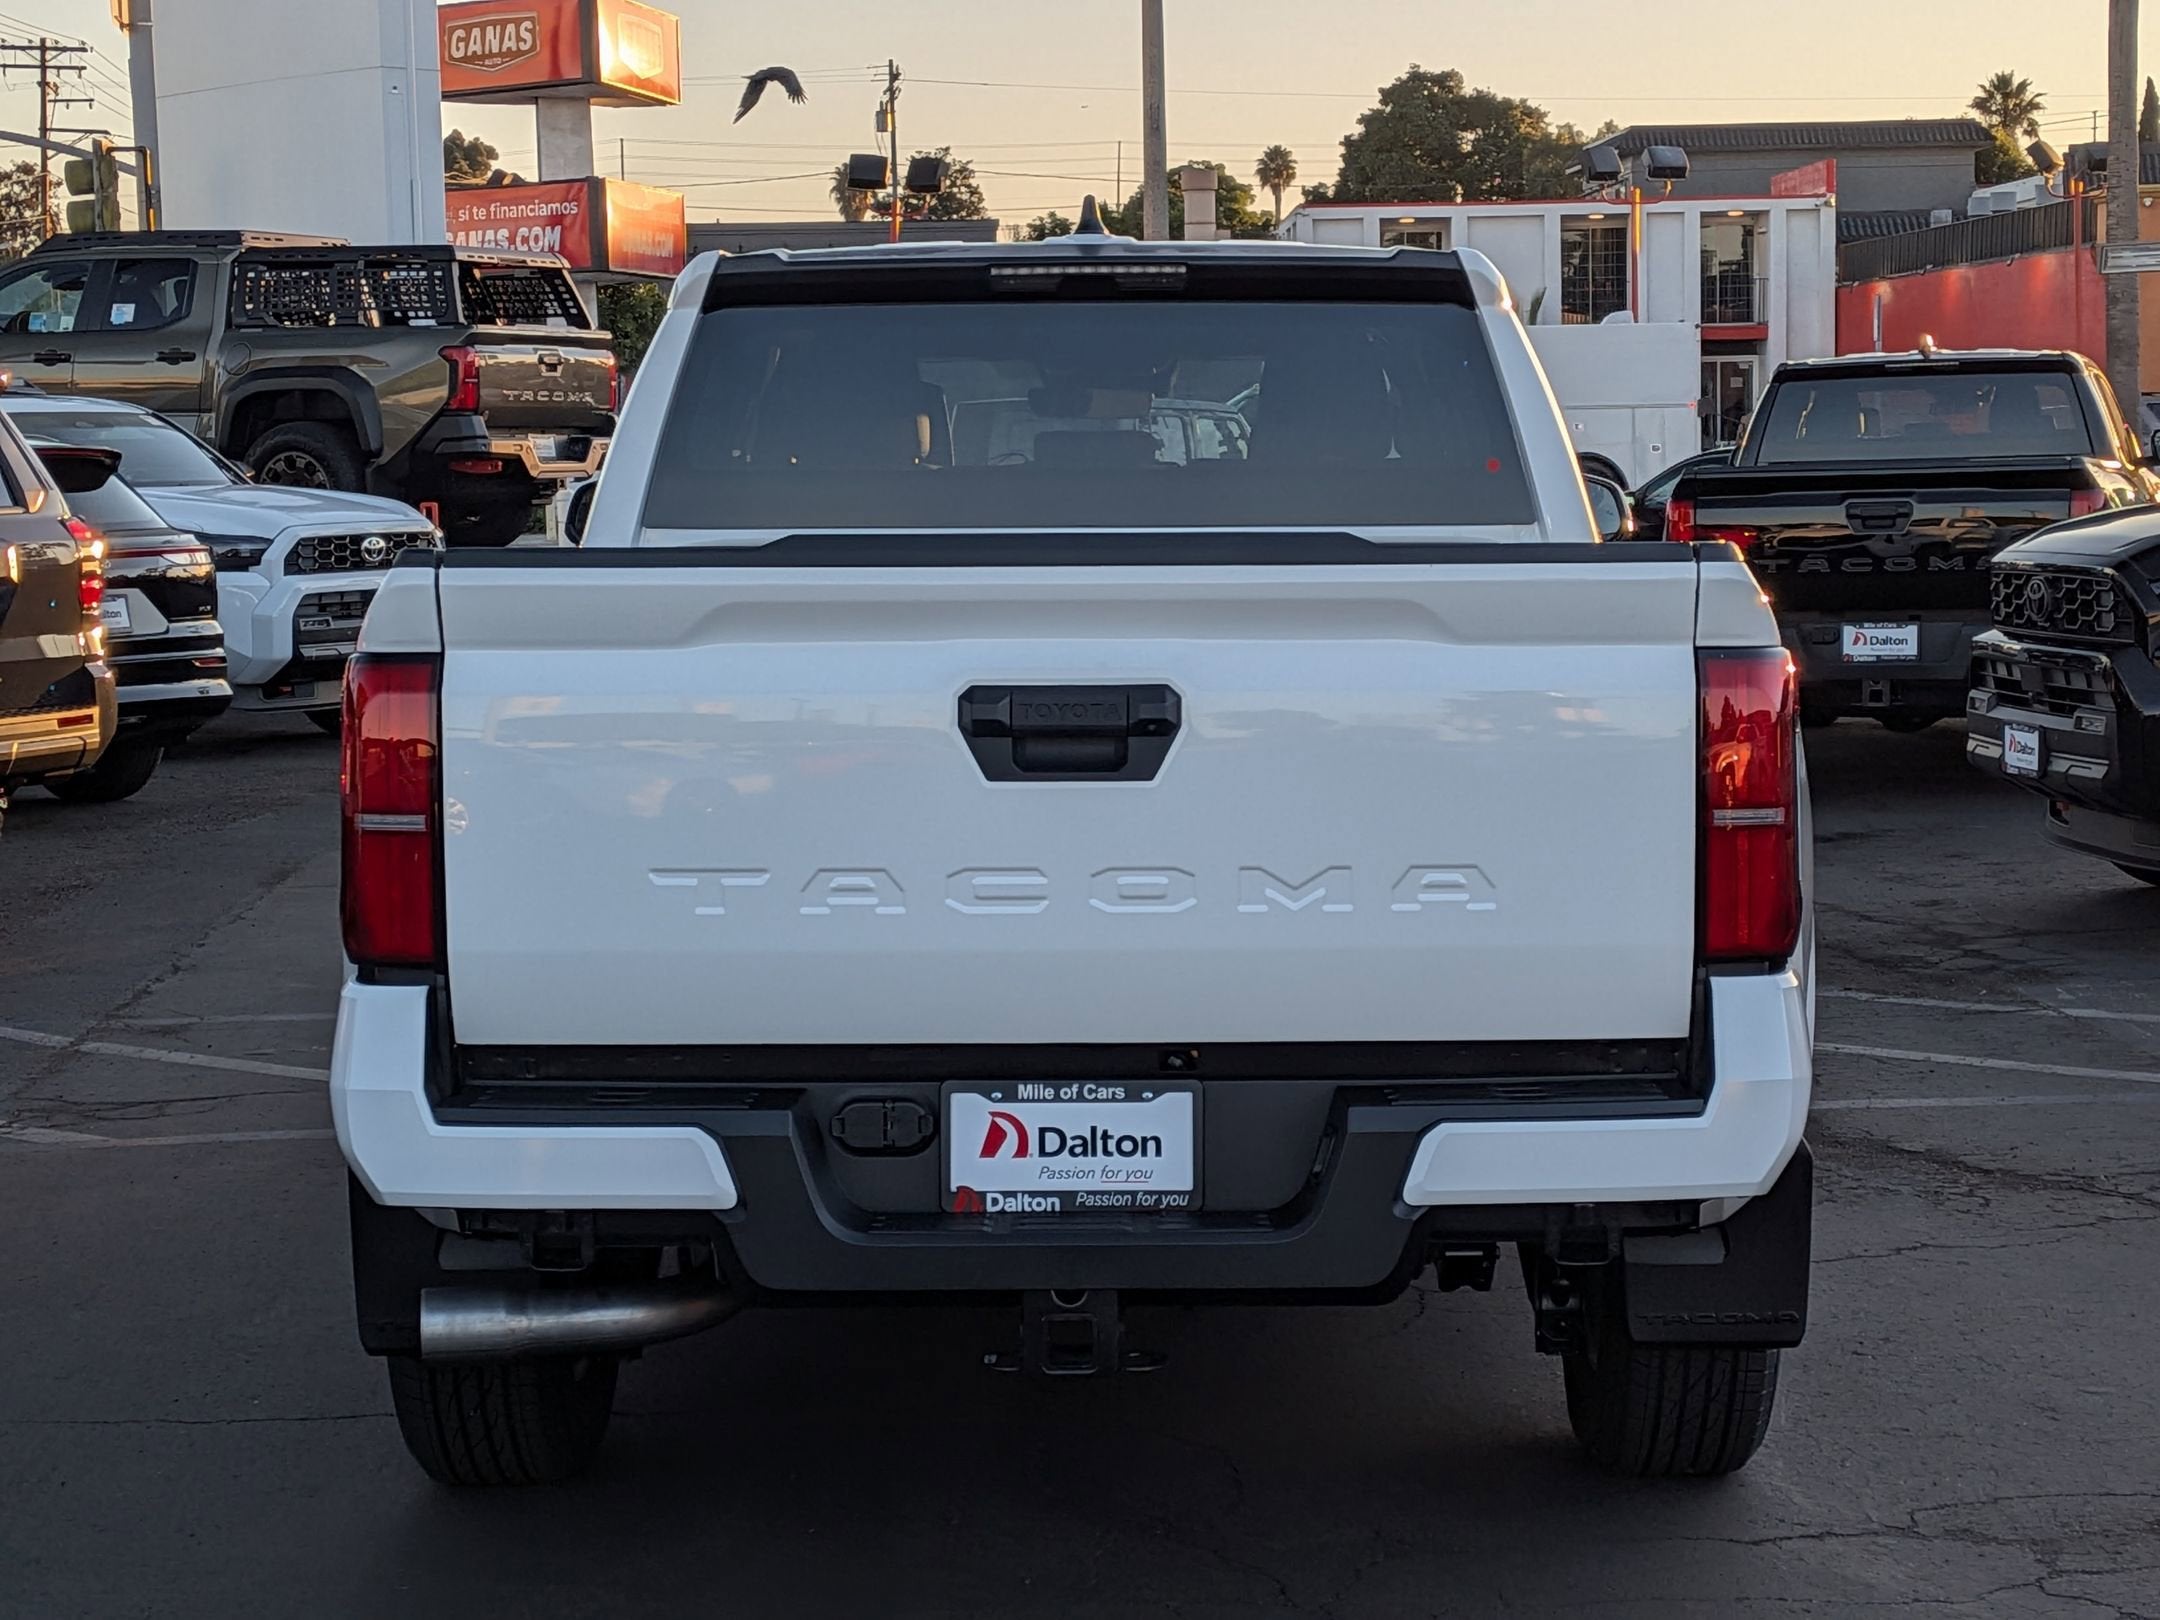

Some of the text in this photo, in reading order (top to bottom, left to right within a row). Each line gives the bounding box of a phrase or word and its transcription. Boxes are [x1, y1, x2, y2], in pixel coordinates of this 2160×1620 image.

[450, 20, 534, 58] GANAS
[472, 205, 487, 220] te
[489, 199, 578, 219] financiamos
[502, 389, 594, 402] TACOMA
[1869, 635, 1909, 646] Dalton
[1018, 702, 1123, 721] TOYOTA
[648, 865, 1498, 916] TACOMA
[1017, 1083, 1126, 1100] Mile of Cars
[1037, 1125, 1162, 1158] Dalton
[1038, 1165, 1153, 1182] Passion for you
[986, 1192, 1061, 1212] Dalton
[1076, 1191, 1189, 1208] Passion for you
